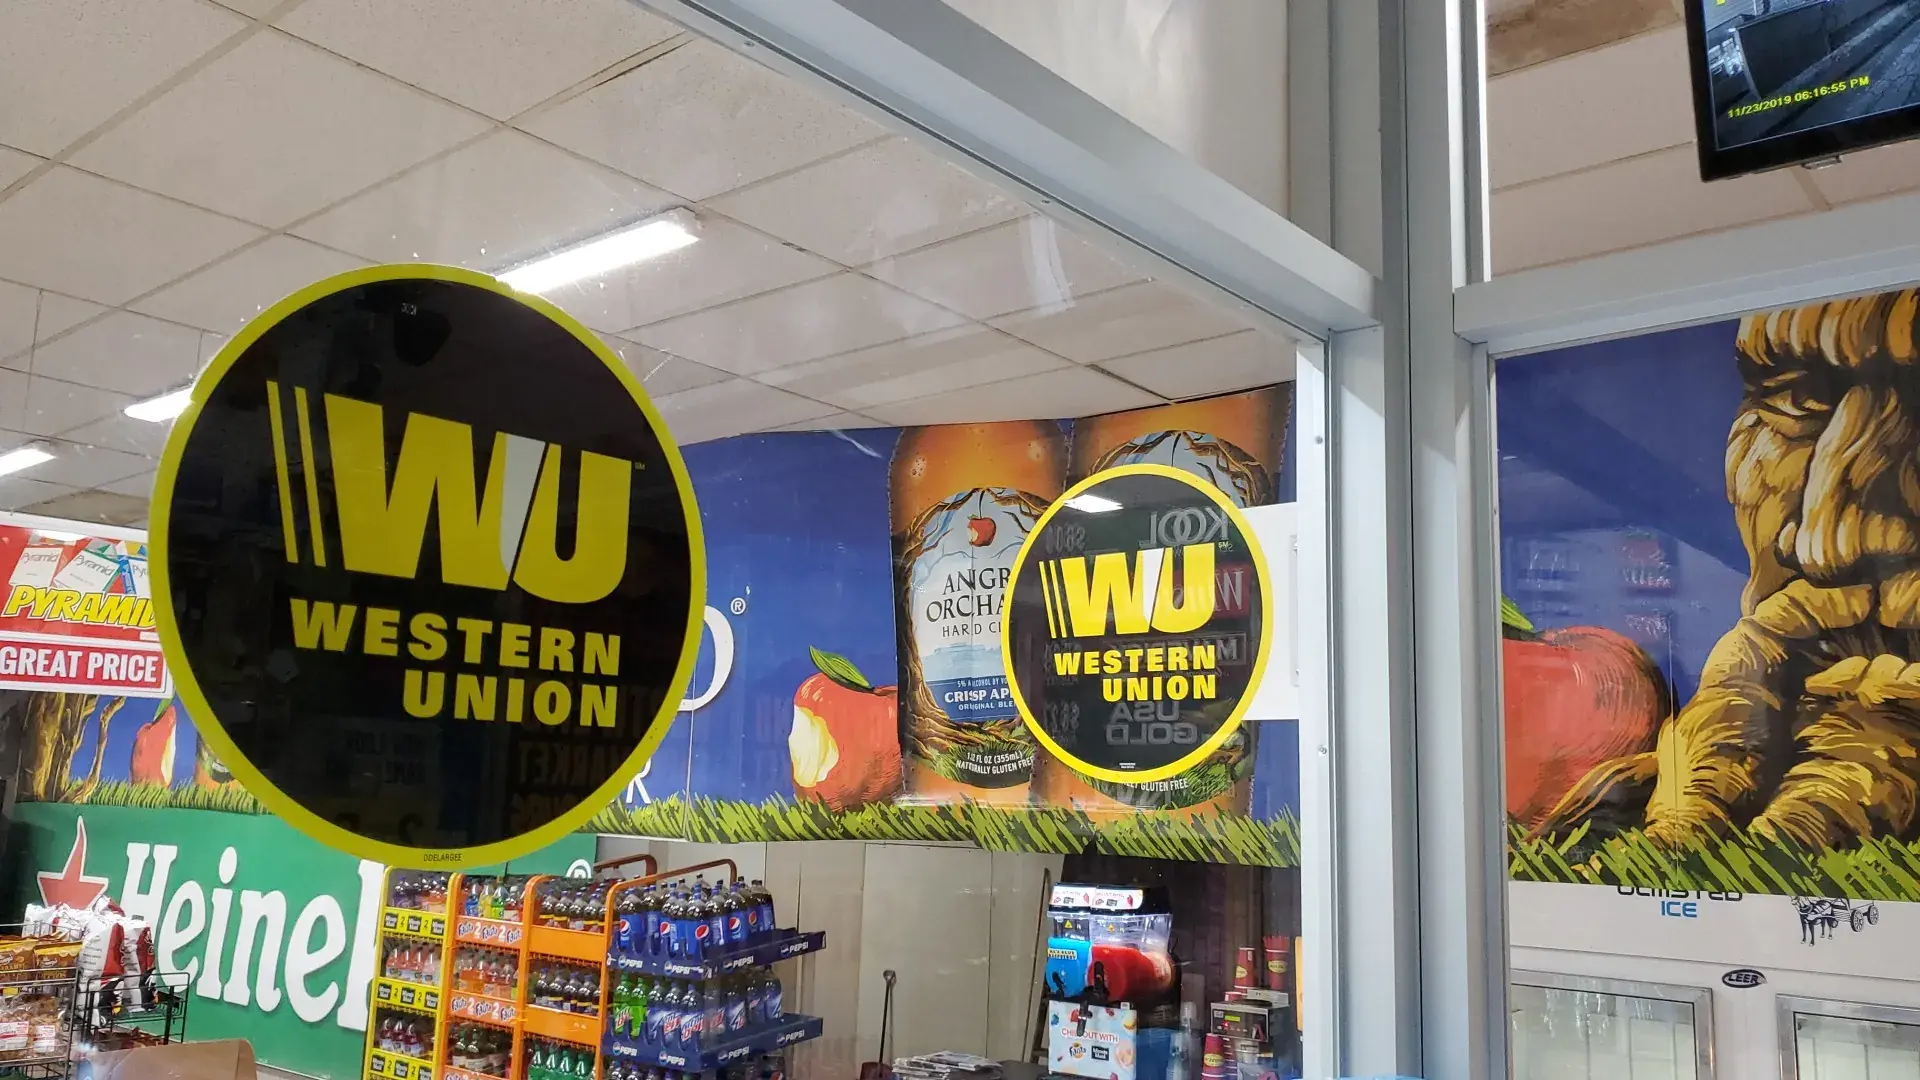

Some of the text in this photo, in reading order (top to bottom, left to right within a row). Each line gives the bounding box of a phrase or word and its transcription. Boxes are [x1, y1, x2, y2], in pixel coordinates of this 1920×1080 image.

[1728, 76, 1870, 118] 11/23/2019 06:16:55 PM
[324, 392, 632, 603] WU
[74, 554, 115, 576] Pyramid
[942, 568, 1011, 595] ANGR
[1061, 542, 1216, 637] WU
[926, 593, 1004, 623] ORCHA
[290, 598, 620, 676] WESTERN
[943, 621, 1001, 637] HARD CI
[0, 646, 158, 682] GREAT PRICE
[1054, 645, 1216, 676] WESTERN
[957, 680, 967, 688] 5%
[1102, 675, 1216, 702] UNION
[403, 669, 618, 727] UNION
[944, 689, 987, 703] CRISP
[958, 703, 995, 711] ORIGINAL
[956, 756, 1034, 775] NATURALLY GLUTEN FREE
[976, 753, 983, 761] FL
[984, 755, 992, 763] OZ
[993, 751, 1023, 765] (355mL)
[1140, 782, 1169, 792] GLUTEN
[1170, 778, 1189, 790] FREE
[1661, 900, 1697, 918] ICE
[499, 925, 506, 942] 2
[789, 941, 809, 953] PEPSI
[625, 959, 643, 968] PEPSI
[733, 955, 754, 968] PEPSI
[1728, 973, 1759, 984] LEER
[785, 1029, 805, 1041] PEPSI
[1084, 1031, 1098, 1040] OUT
[1099, 1033, 1119, 1043] WITH
[620, 1046, 638, 1057] PEPSI
[728, 1046, 750, 1060] PEPSI
[667, 1055, 685, 1066] PEPSI
